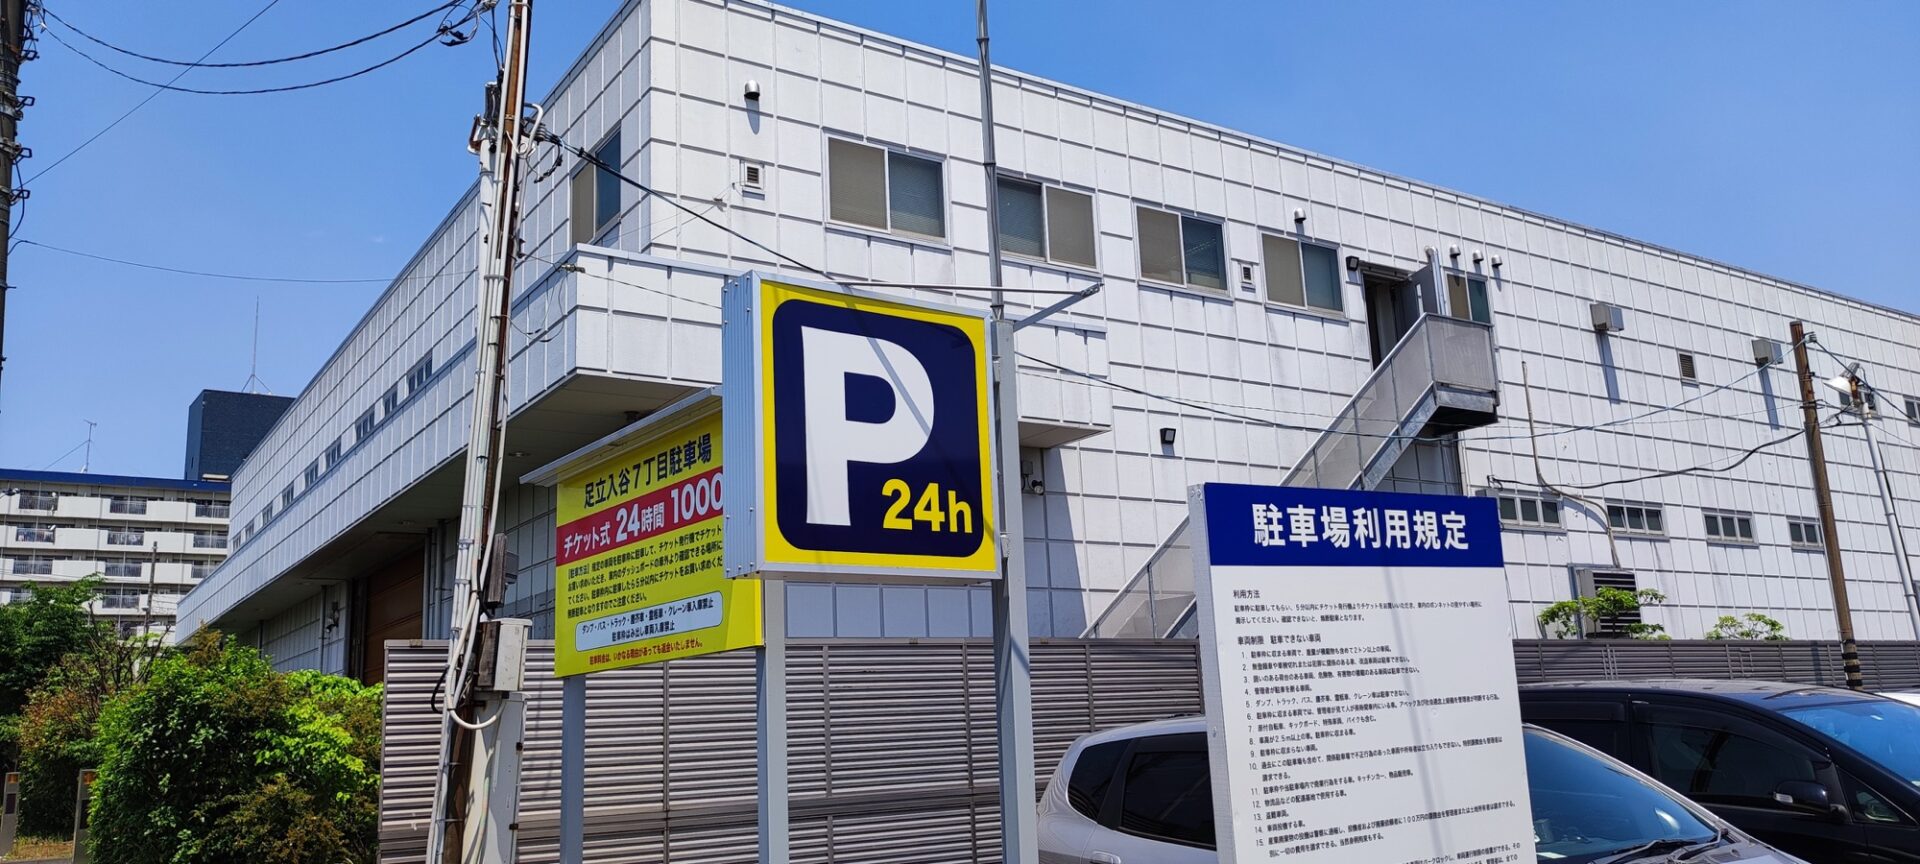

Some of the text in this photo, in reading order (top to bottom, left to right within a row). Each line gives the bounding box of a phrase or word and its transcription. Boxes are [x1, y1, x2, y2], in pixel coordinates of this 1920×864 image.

[801, 326, 934, 526] P
[584, 433, 712, 509] 足立入谷7丁目駐車場
[563, 472, 723, 558] チケット式 24時間 1000
[882, 479, 972, 533] 24h
[1252, 503, 1470, 550] 駐車場利用規定
[1233, 589, 1260, 599] 利用方法
[1237, 633, 1321, 646] 車両制限 駐車できない車両
